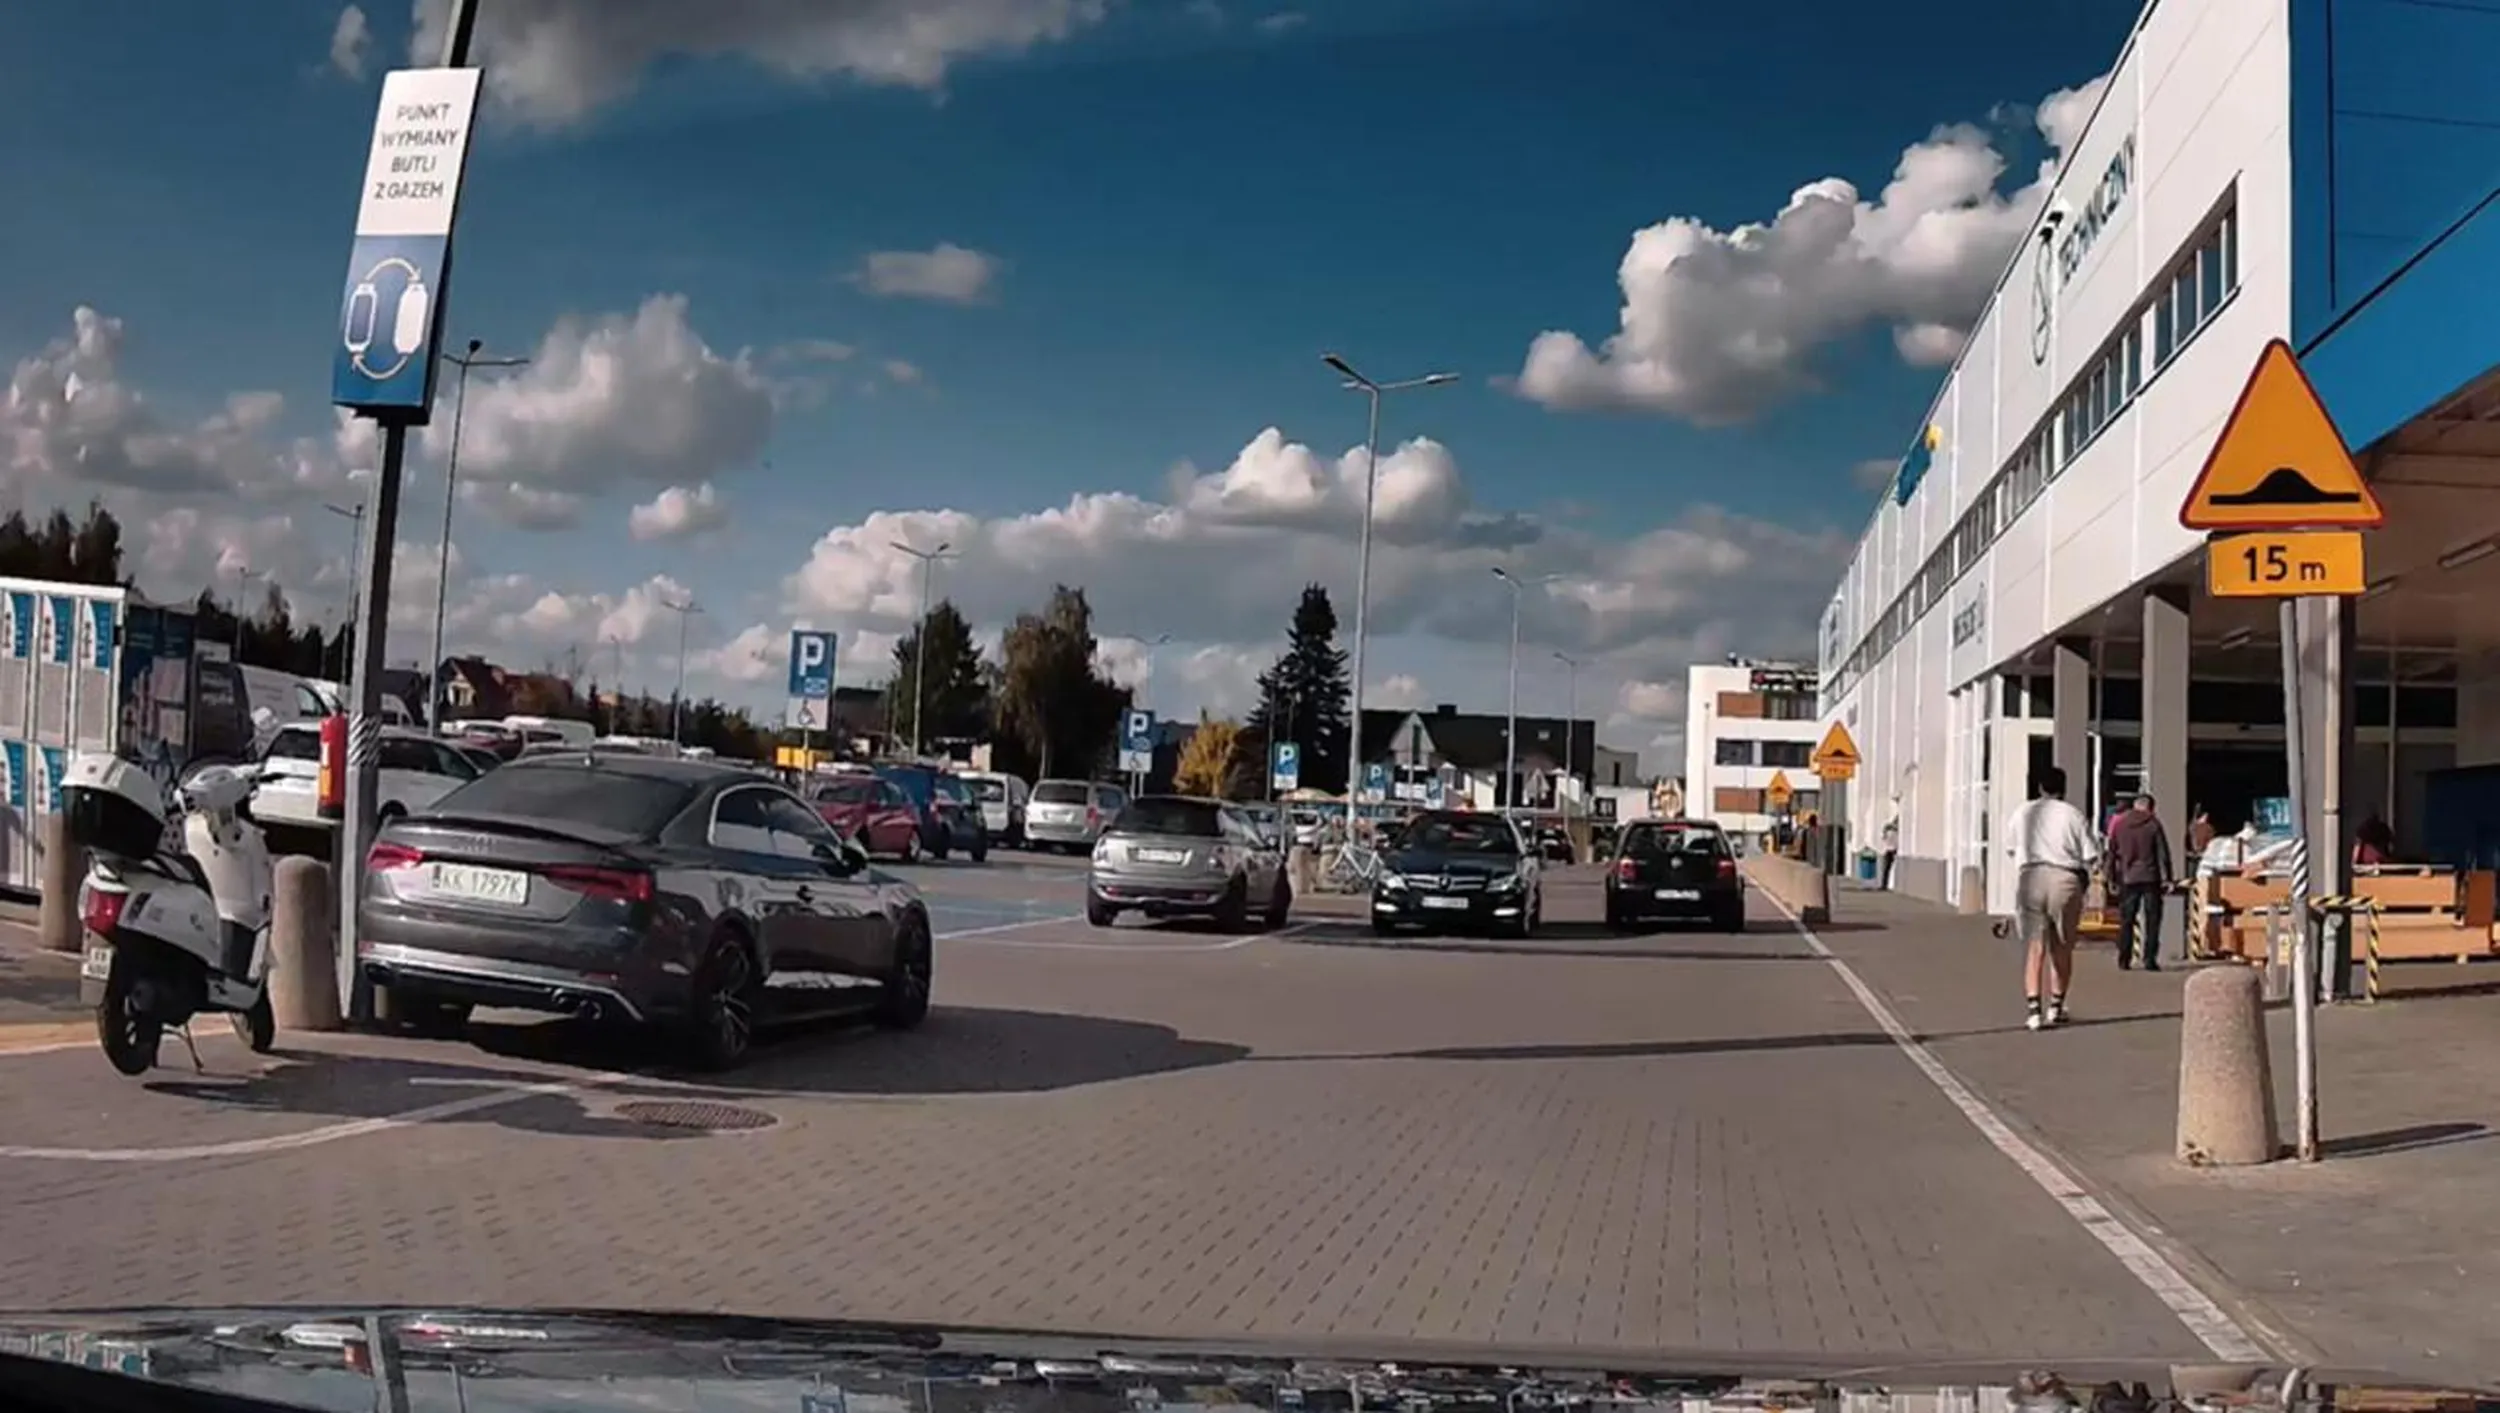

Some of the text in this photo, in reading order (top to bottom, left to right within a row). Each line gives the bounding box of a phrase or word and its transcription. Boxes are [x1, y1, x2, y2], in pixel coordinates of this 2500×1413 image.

[396, 102, 451, 120] PUNKT
[381, 128, 459, 148] WYMIANY
[391, 155, 437, 174] BUTLI
[374, 181, 444, 200] Z GAZEM
[2243, 545, 2326, 582] 15 m
[798, 635, 825, 676] P
[1128, 712, 1148, 738] P
[1279, 744, 1294, 765] P
